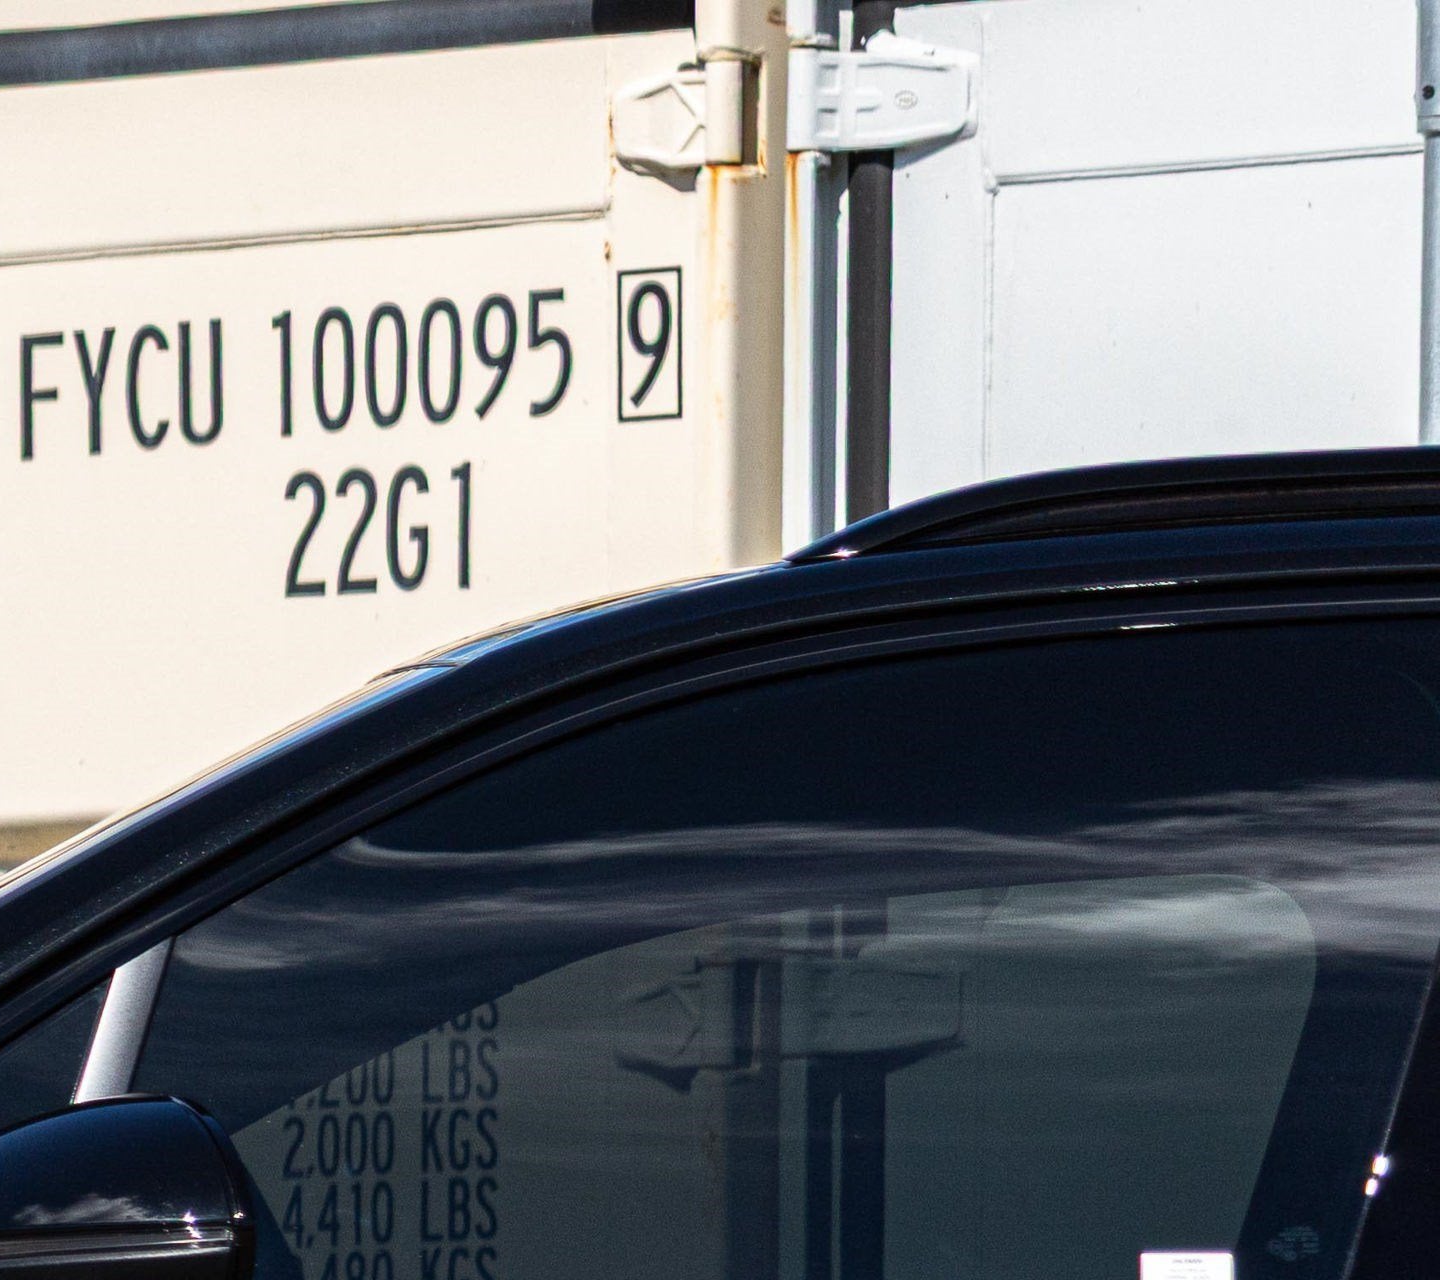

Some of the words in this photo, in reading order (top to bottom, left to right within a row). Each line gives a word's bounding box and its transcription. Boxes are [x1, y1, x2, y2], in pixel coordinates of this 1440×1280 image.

[18, 317, 224, 462] FYCU
[271, 287, 574, 438] 100095
[626, 280, 672, 407] 9
[283, 462, 473, 598] 22G1
[422, 1038, 499, 1103] LBS
[421, 1108, 499, 1173] KGS
[283, 1181, 394, 1249] 4,410
[421, 1176, 499, 1242] LBS
